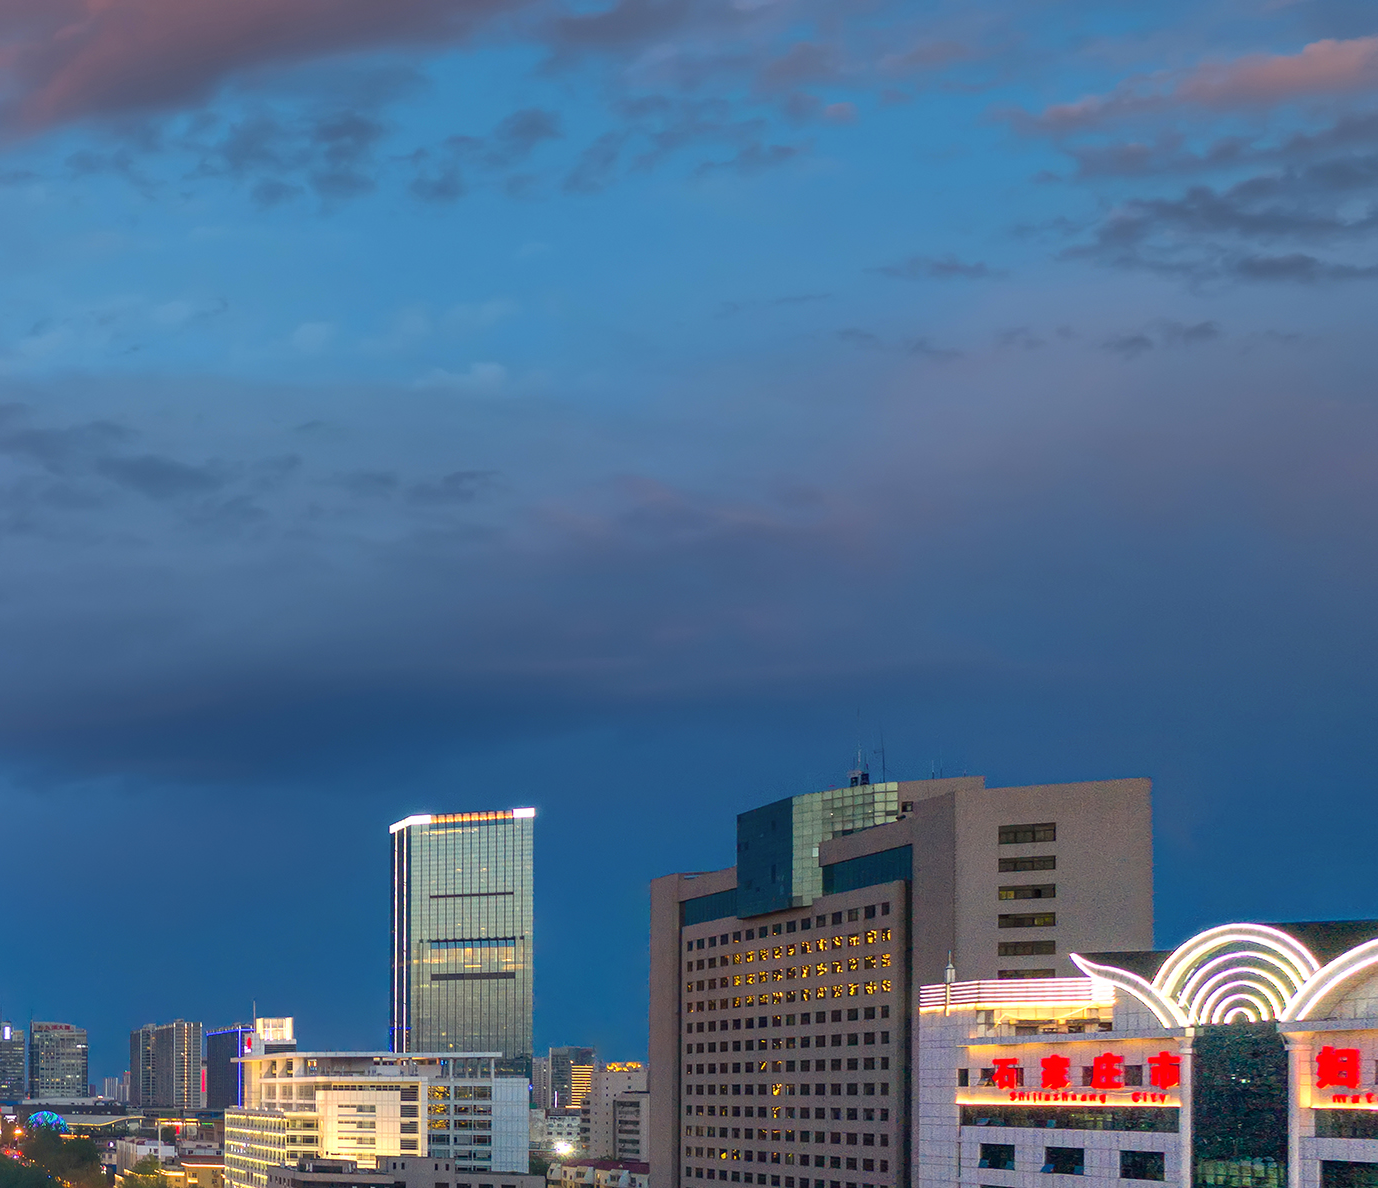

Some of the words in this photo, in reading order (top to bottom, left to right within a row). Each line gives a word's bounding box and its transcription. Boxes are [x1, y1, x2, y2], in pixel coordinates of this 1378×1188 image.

[992, 1050, 1182, 1090] 石家庄市
[1131, 1091, 1167, 1104] City
